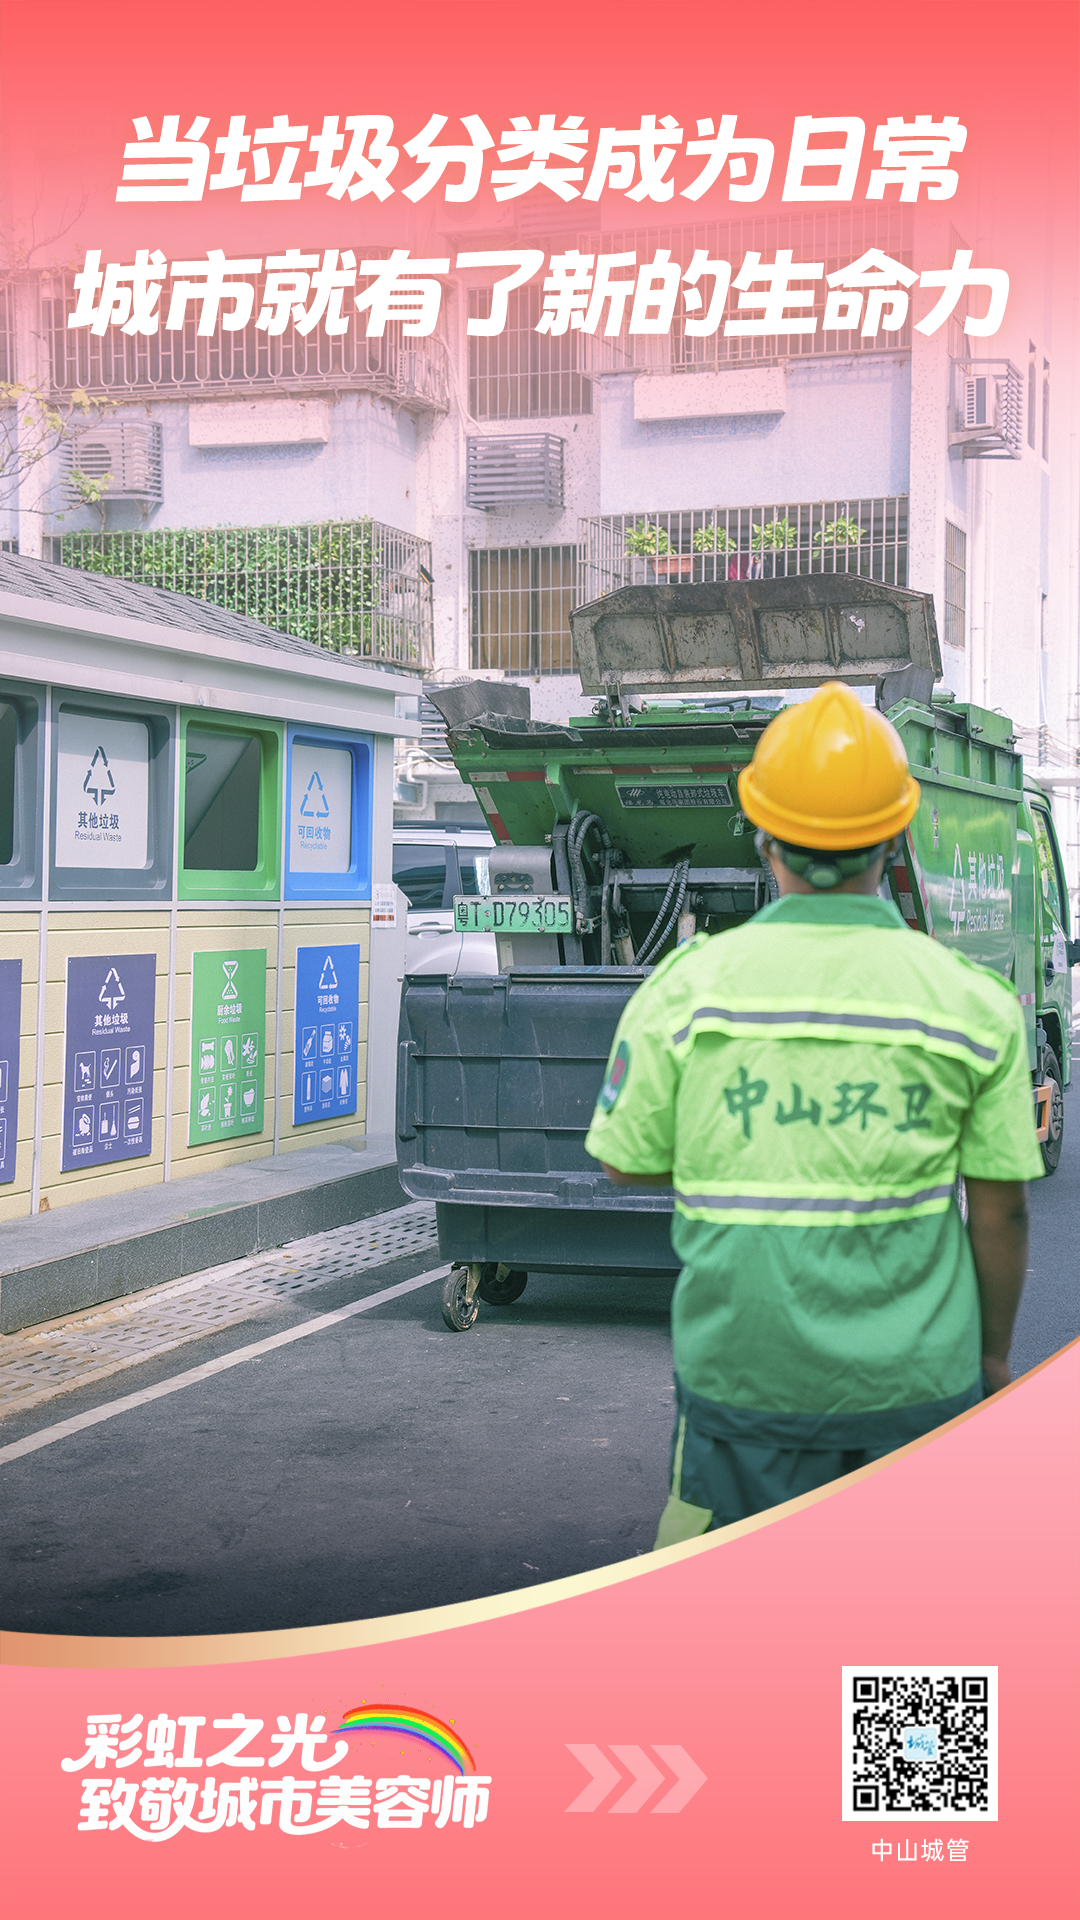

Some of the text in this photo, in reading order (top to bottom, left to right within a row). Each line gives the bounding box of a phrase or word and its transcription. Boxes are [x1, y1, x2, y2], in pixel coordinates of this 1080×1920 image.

[77, 810, 120, 830] 其他垃圾
[74, 830, 122, 842] Residual Waste
[297, 824, 331, 841] 可回收物
[300, 840, 328, 851] Recyclable
[967, 851, 1005, 900] 其他垃圾
[966, 907, 1005, 932] Residual Waste
[317, 993, 340, 1005] 可回收物
[216, 1002, 243, 1016] 厨余垃圾
[94, 1012, 129, 1027] 其他垃圾
[91, 1025, 131, 1036] Residual Waste
[722, 1065, 933, 1140] 中山环卫
